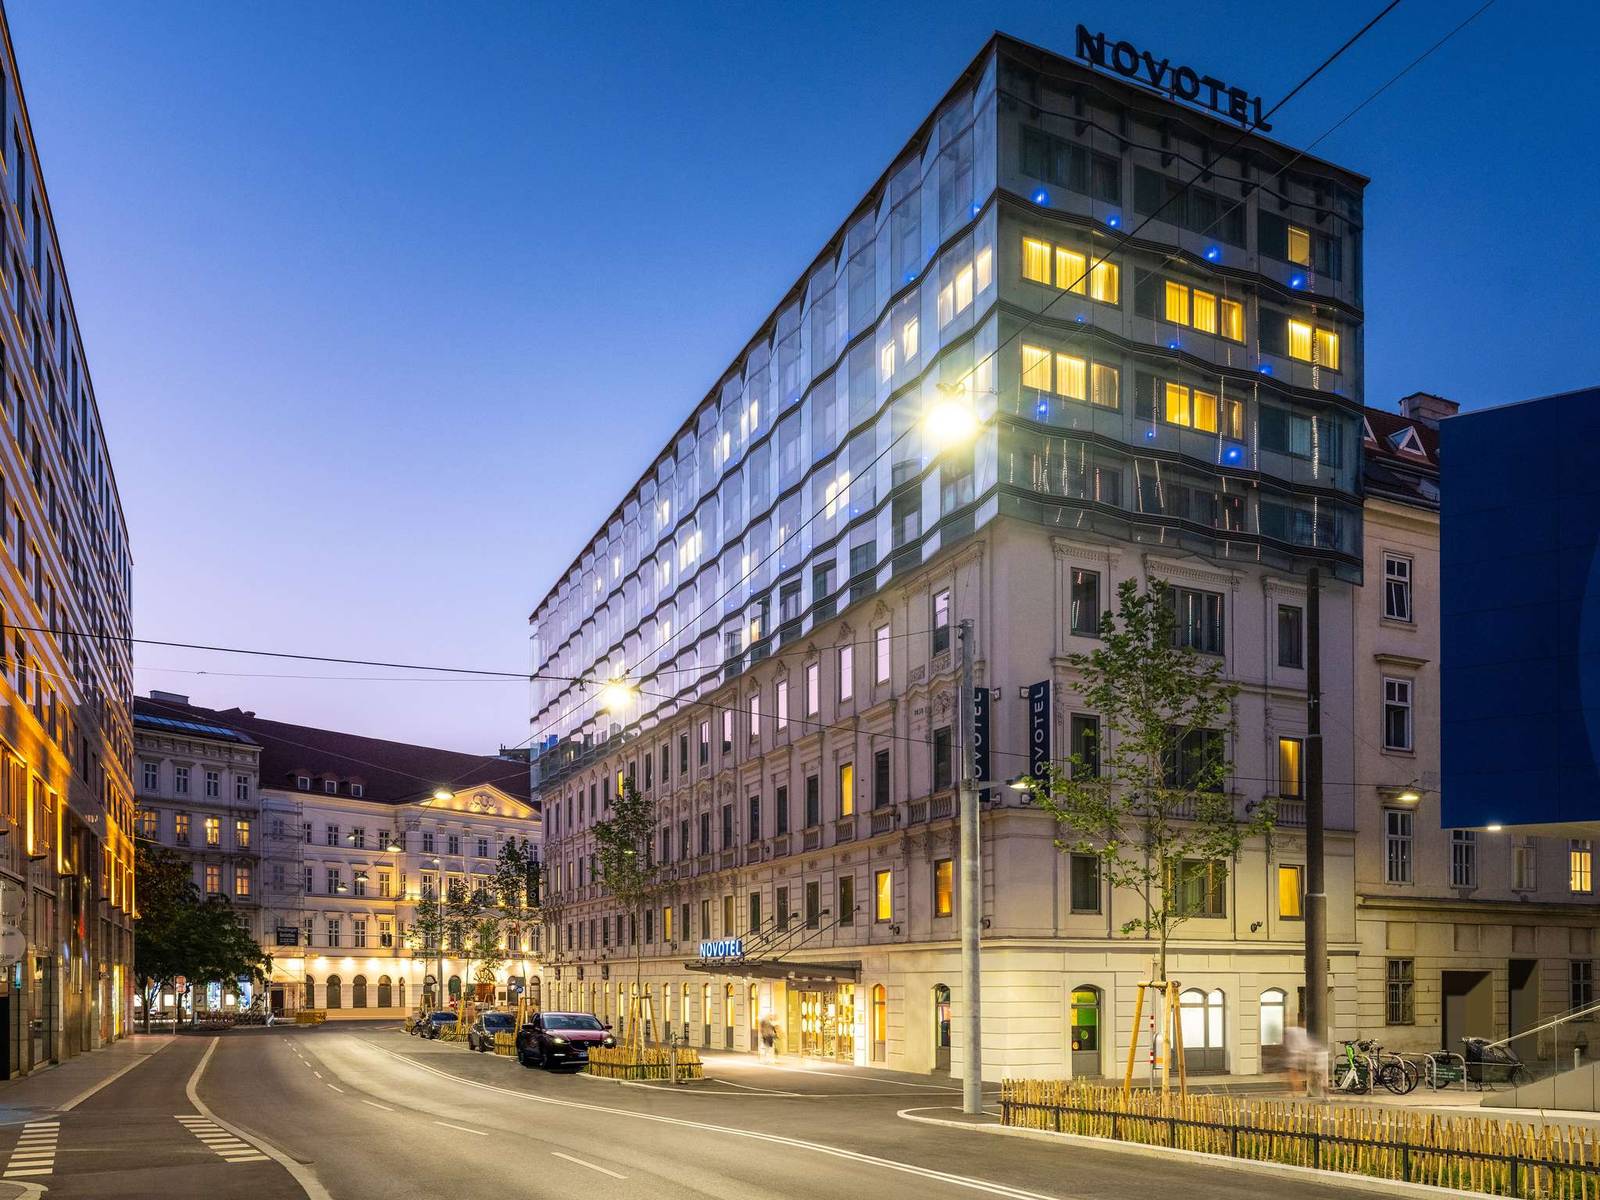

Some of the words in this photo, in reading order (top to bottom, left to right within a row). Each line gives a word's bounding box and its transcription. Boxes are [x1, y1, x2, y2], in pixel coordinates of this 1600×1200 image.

[1076, 24, 1272, 132] NOVOTEL
[1034, 686, 1045, 778] OVOTEL
[700, 940, 741, 957] NOVOTEL
